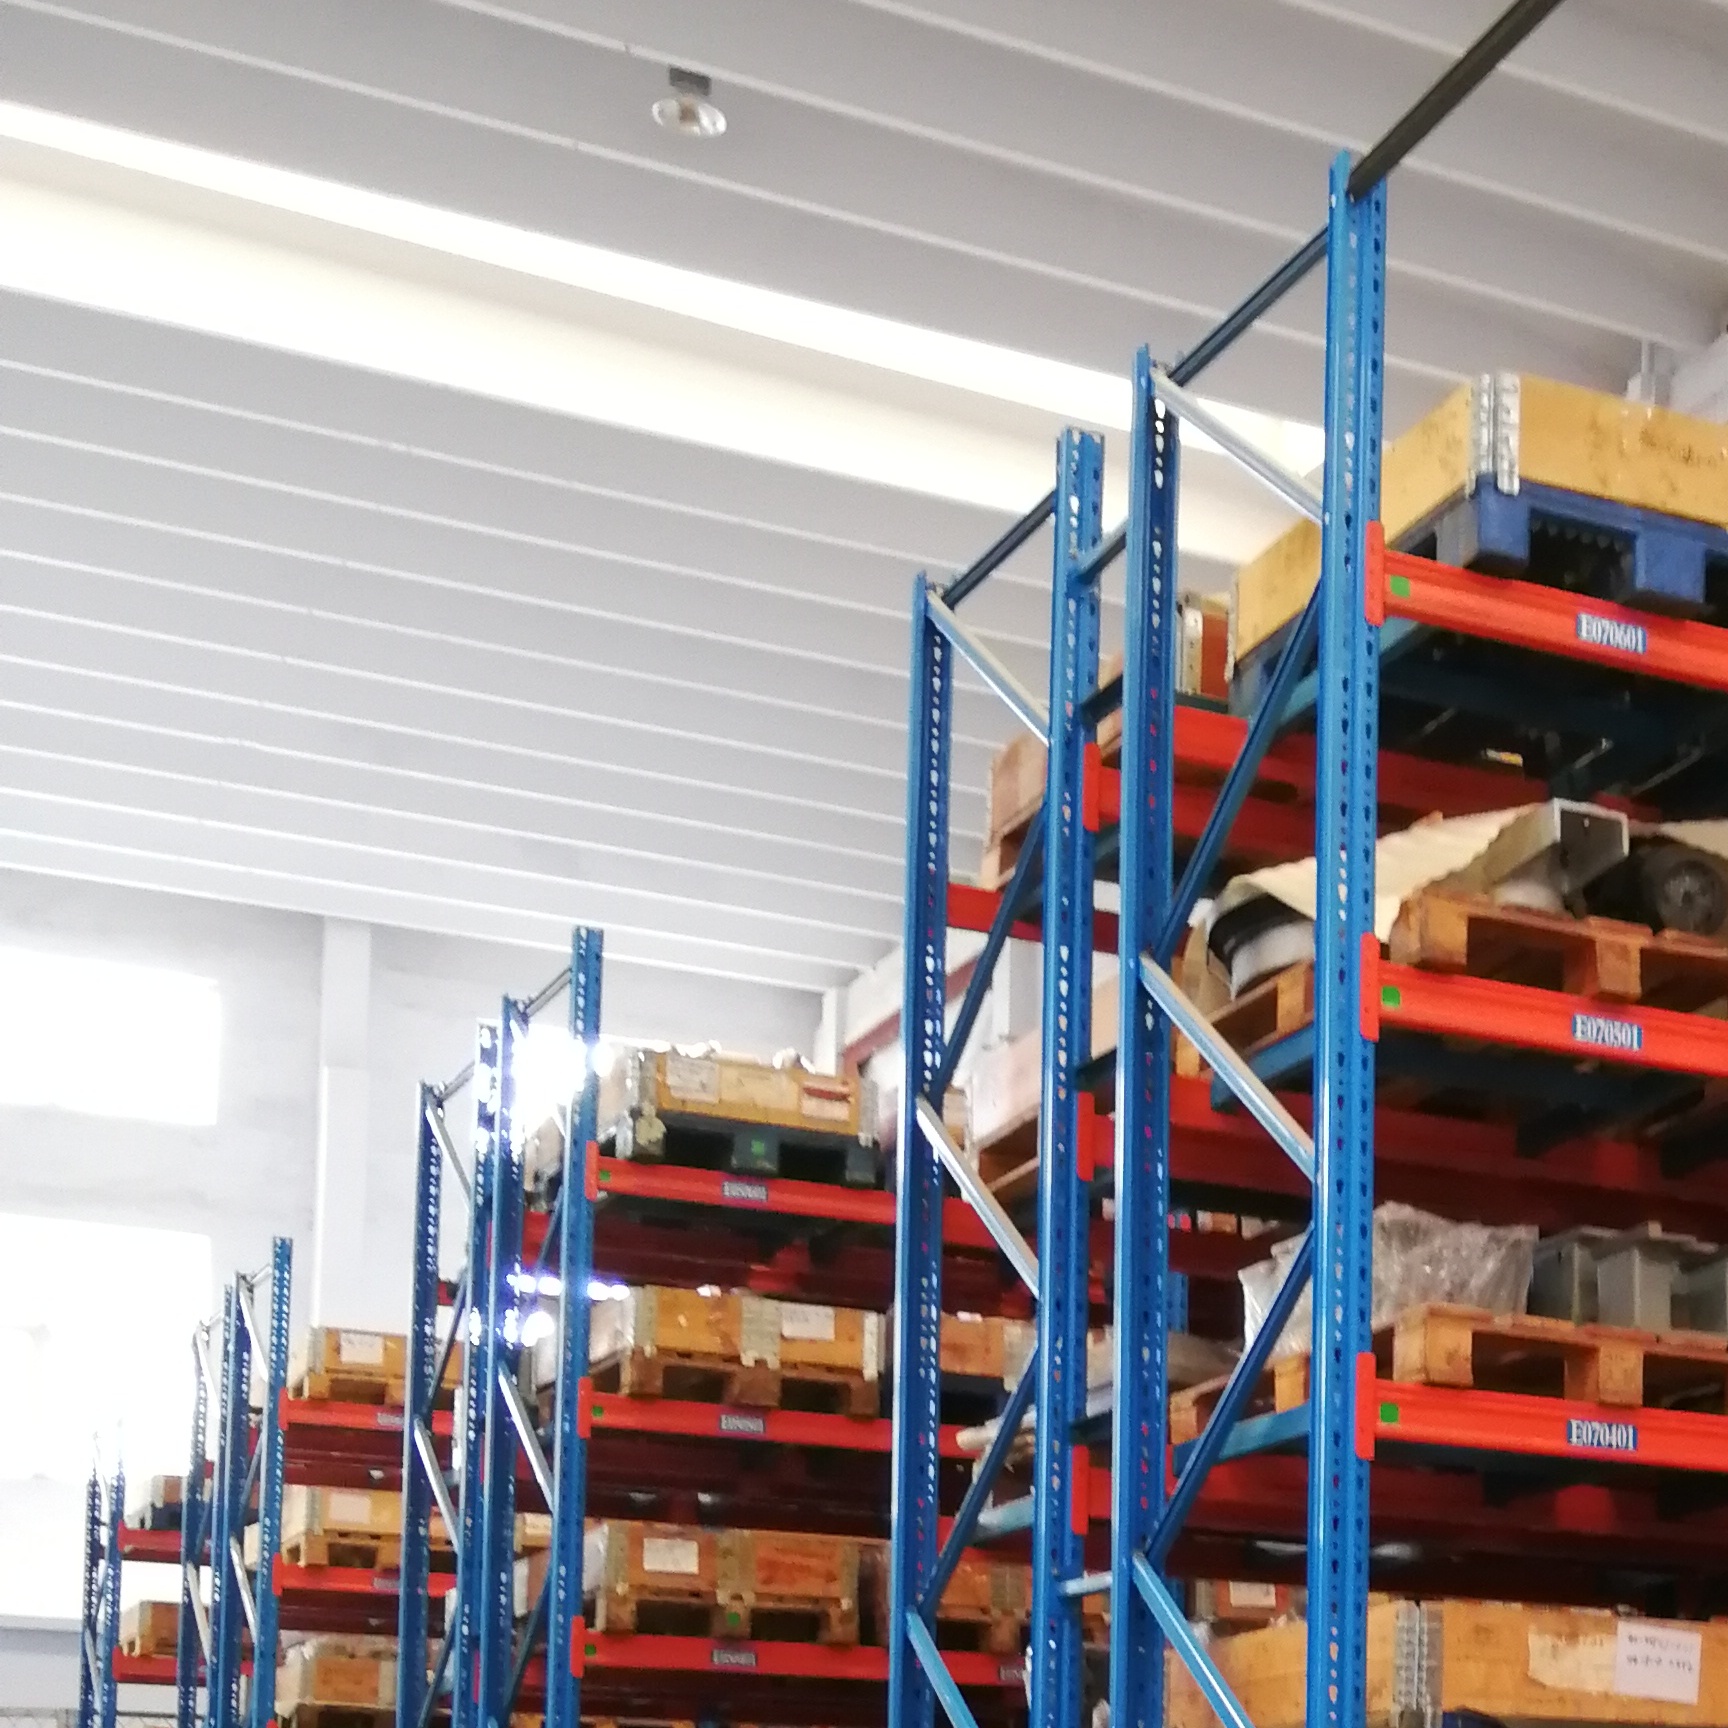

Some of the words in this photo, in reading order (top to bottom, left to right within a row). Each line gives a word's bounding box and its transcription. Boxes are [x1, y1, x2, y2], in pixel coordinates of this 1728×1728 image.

[1580, 613, 1644, 654] E070601
[1573, 1014, 1638, 1051] E070501
[1569, 1419, 1635, 1451] E070401
